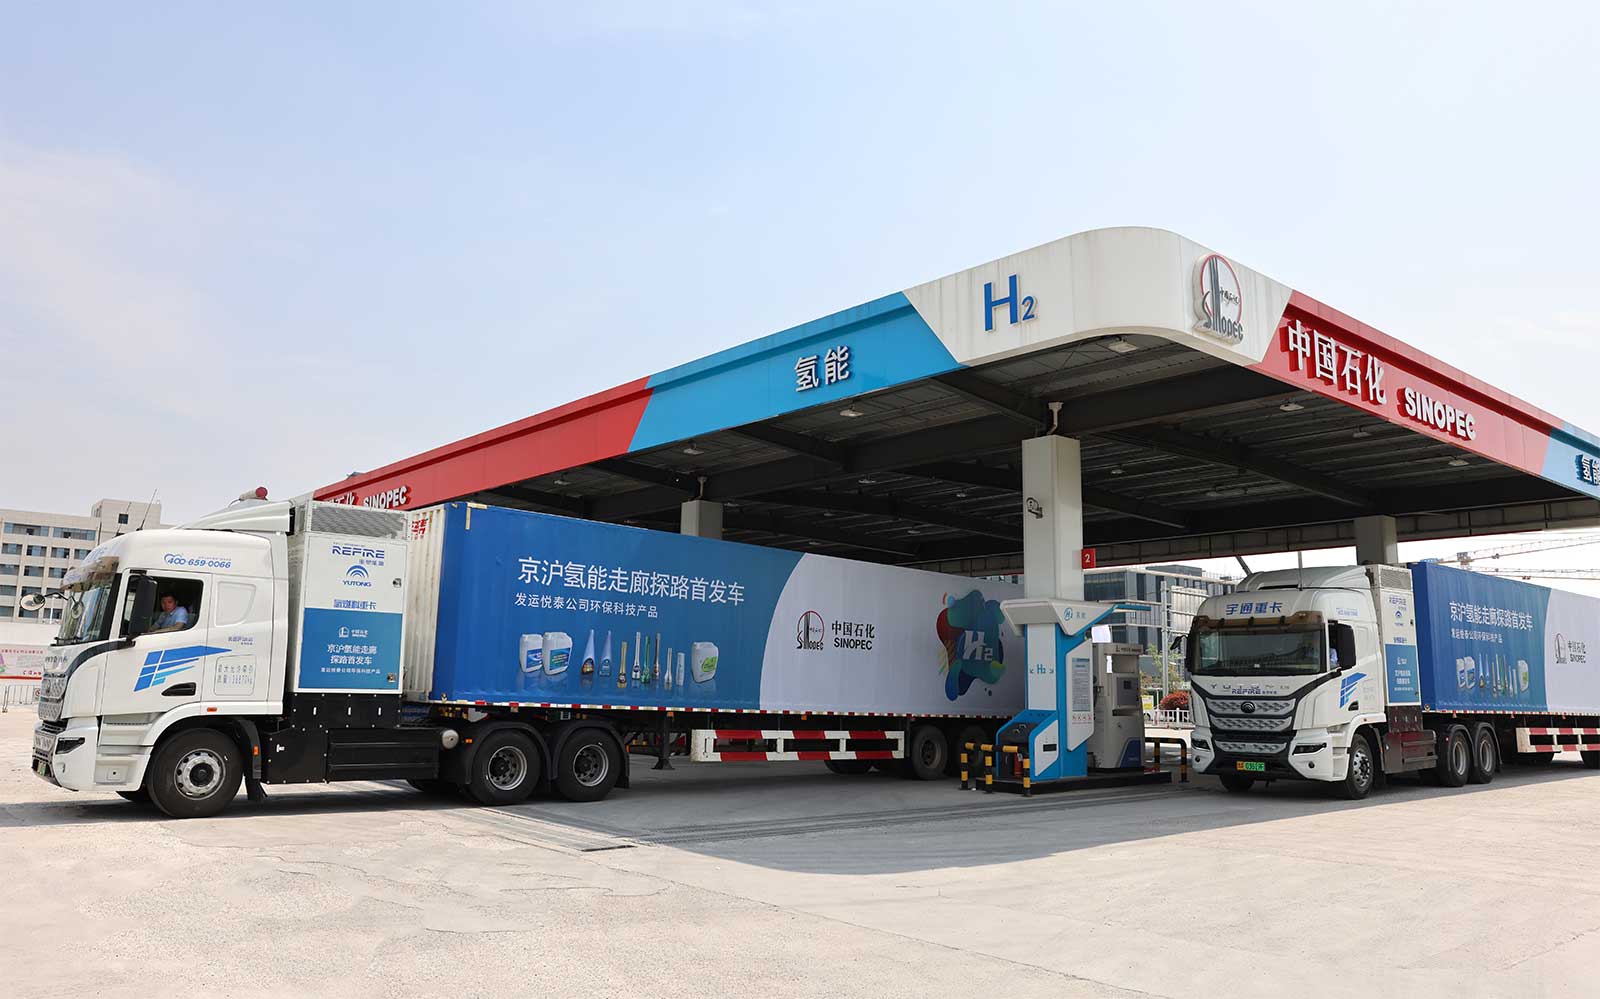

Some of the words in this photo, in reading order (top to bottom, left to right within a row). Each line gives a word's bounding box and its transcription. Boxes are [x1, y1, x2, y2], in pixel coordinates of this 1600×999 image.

[984, 273, 1036, 332] H2
[793, 345, 851, 393] 氢能
[1287, 319, 1388, 405] 中国石化
[1404, 387, 1477, 441] SINOPEC
[363, 486, 407, 509] SINOPEC
[332, 545, 385, 559] REFIRE
[1084, 553, 1091, 563] 2
[342, 579, 373, 588] YUTONG
[517, 556, 746, 607] 京沪氢能走廊探路首发车
[514, 591, 659, 619] 发运悦泰公司环保科技产品
[1226, 601, 1283, 616] 宇通重卡
[831, 620, 875, 639] 中国石化
[833, 637, 873, 651] SINOPEC
[962, 630, 995, 662] H2
